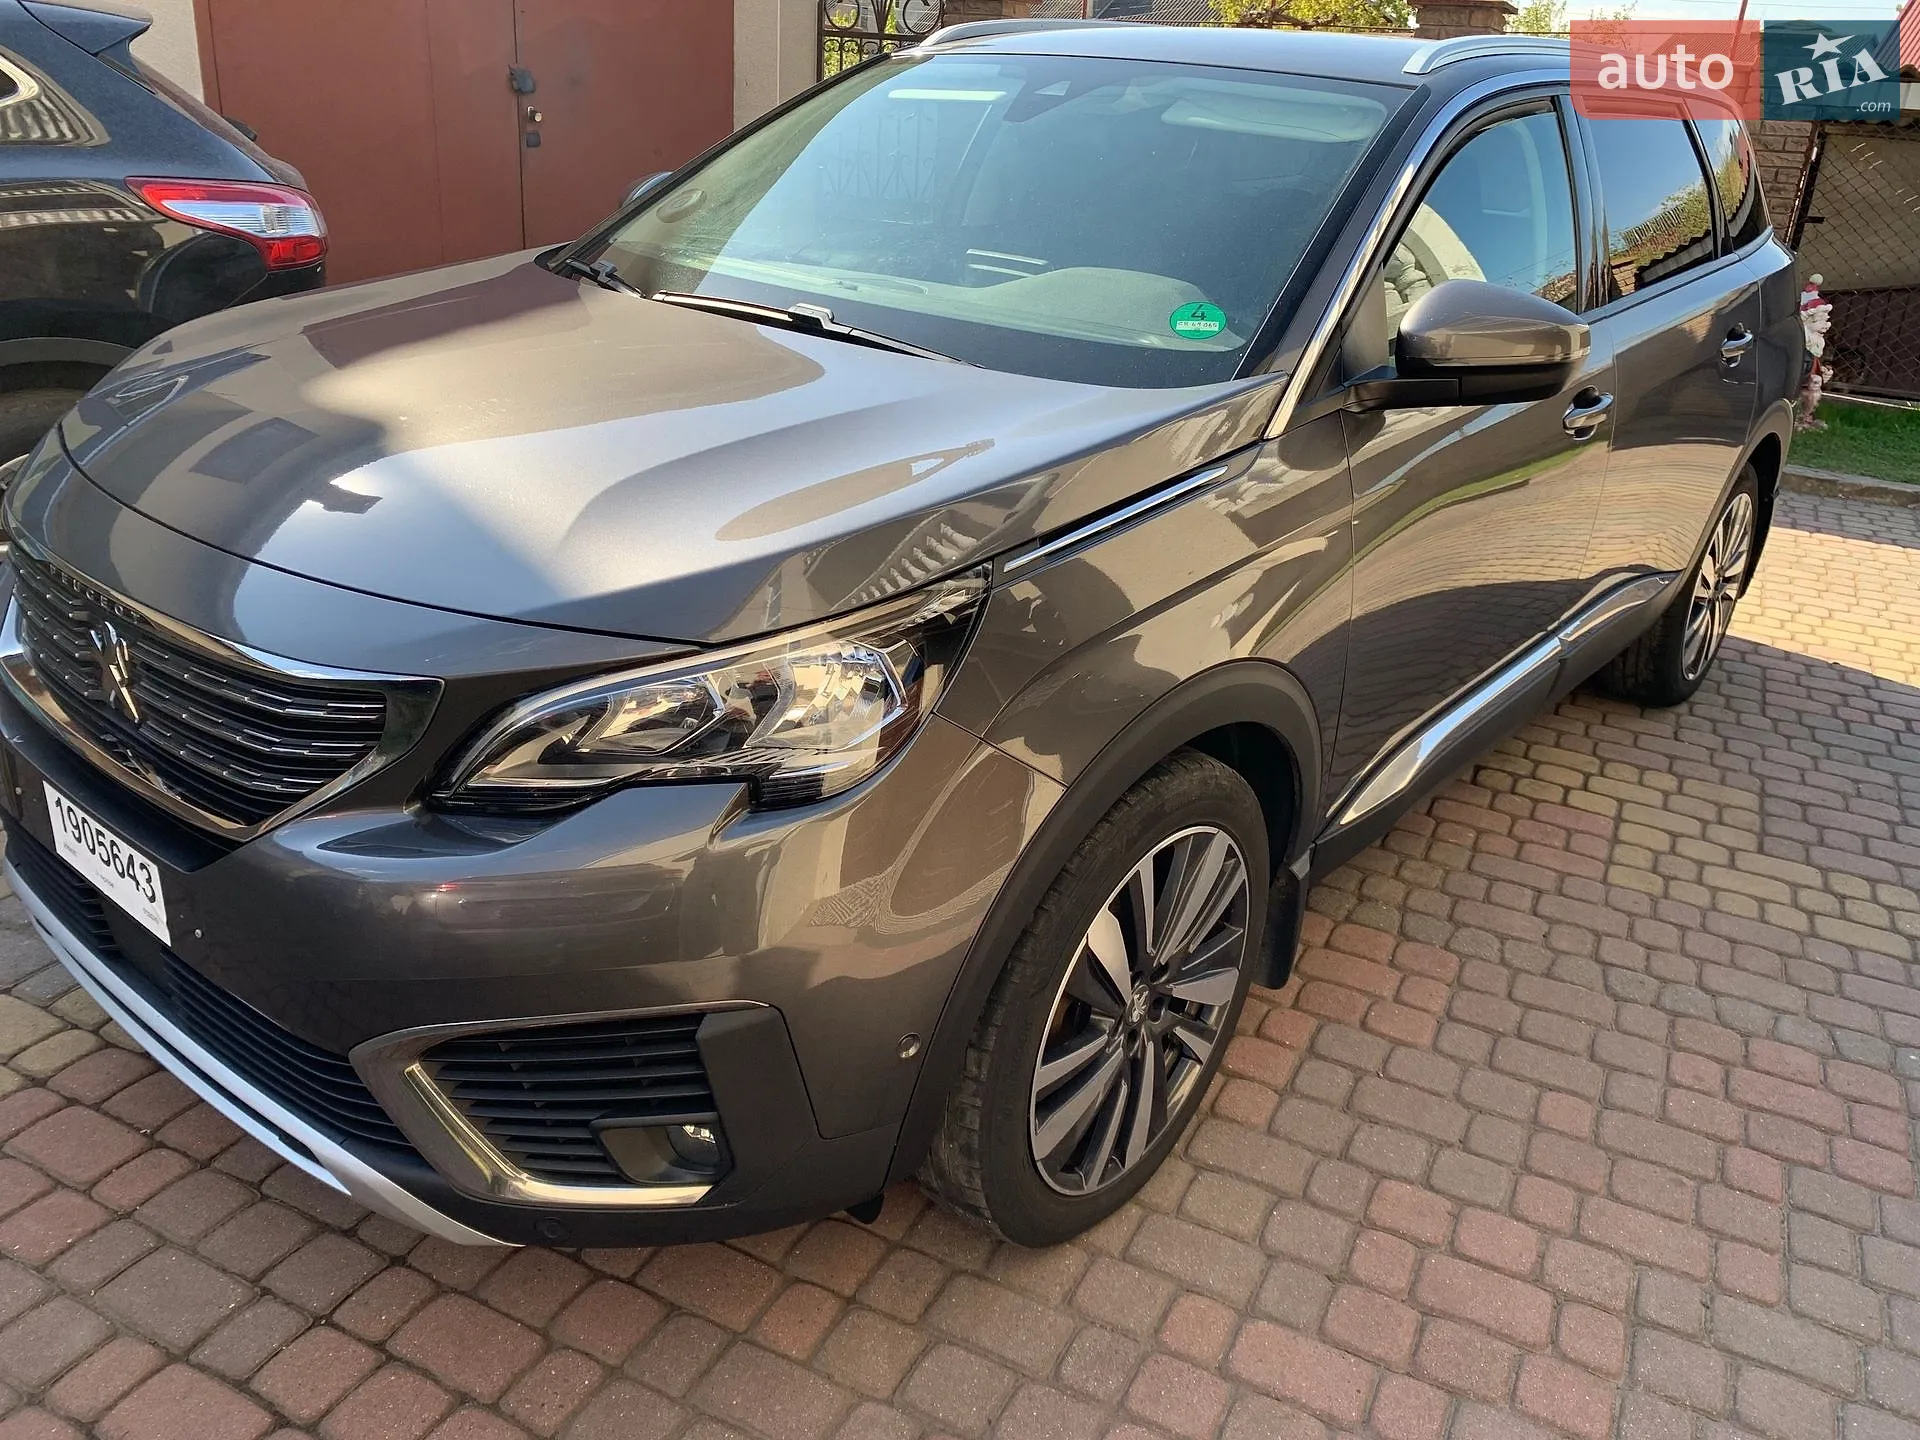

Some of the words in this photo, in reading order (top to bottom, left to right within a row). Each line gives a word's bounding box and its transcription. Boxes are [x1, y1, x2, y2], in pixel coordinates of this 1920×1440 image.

[1191, 304, 1206, 320] 4
[49, 563, 140, 624] PEUGEOT
[54, 796, 156, 904] 1905643
